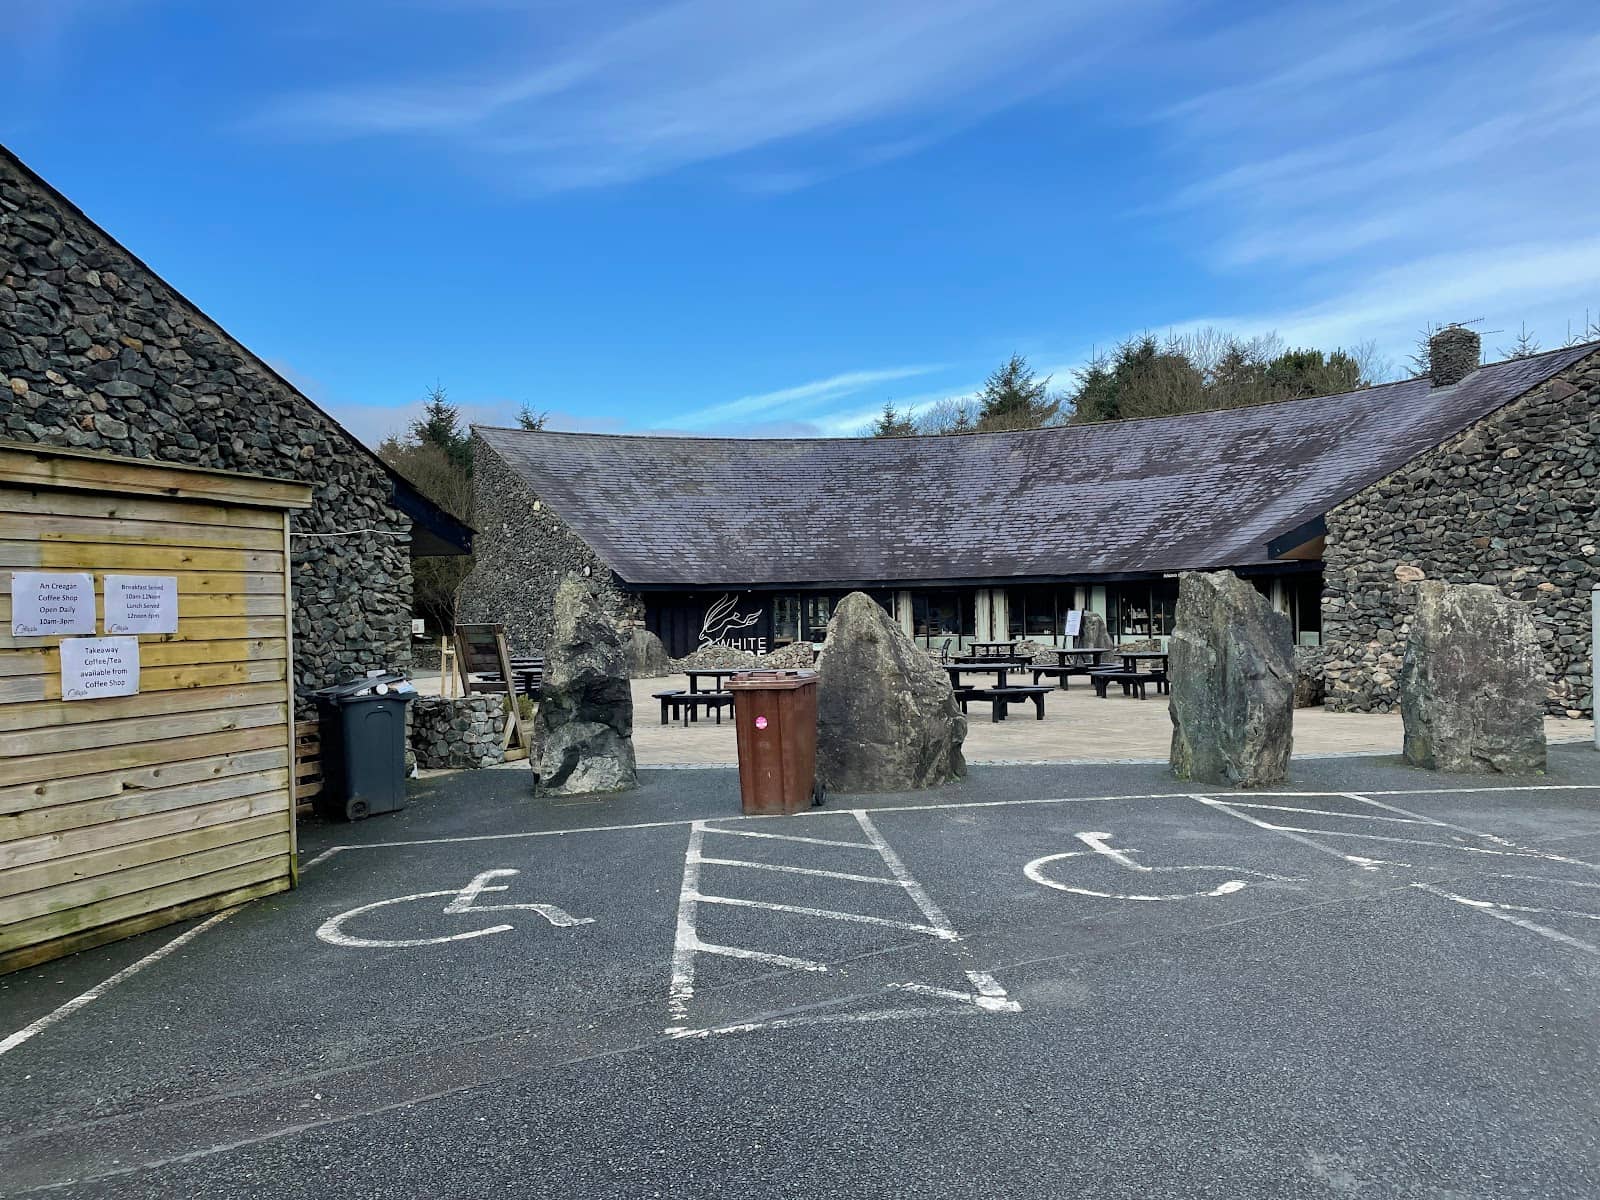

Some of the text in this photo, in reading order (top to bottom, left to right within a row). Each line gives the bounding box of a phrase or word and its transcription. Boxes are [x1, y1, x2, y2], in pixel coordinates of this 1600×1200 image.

[62, 594, 78, 602] Shop
[39, 606, 76, 614] Open Daily
[39, 618, 75, 626] 10am-3pm
[716, 637, 767, 650] WHITE
[84, 657, 122, 666] Coffee/Tea
[80, 669, 111, 677] available
[109, 679, 126, 687] Shop
